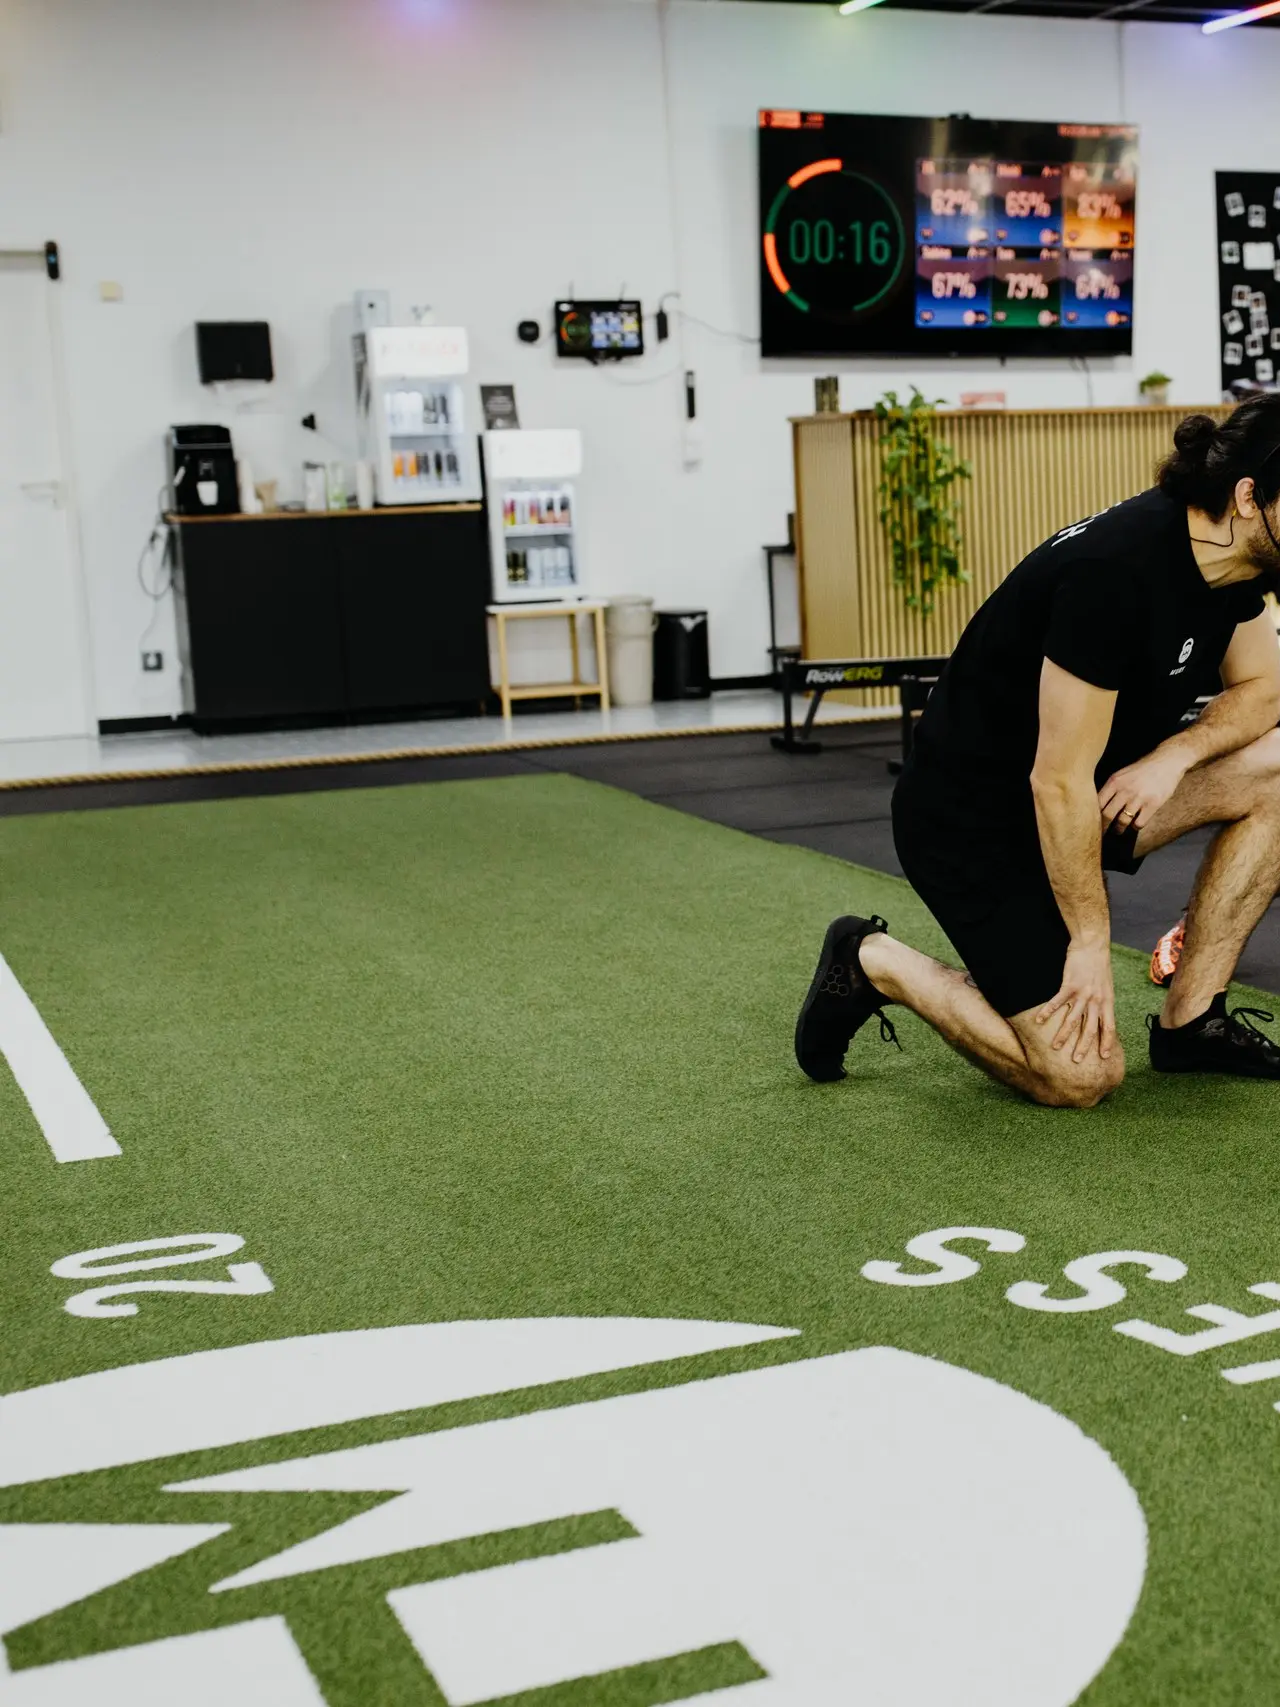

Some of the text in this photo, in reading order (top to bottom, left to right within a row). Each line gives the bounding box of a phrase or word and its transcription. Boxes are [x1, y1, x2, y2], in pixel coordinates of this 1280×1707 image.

[931, 188, 978, 217] 62%
[1005, 191, 1051, 219] 65%
[788, 219, 892, 266] 00:16
[931, 271, 976, 300] 67%
[1005, 273, 1049, 300] 73%
[50, 1233, 274, 1319] 20
